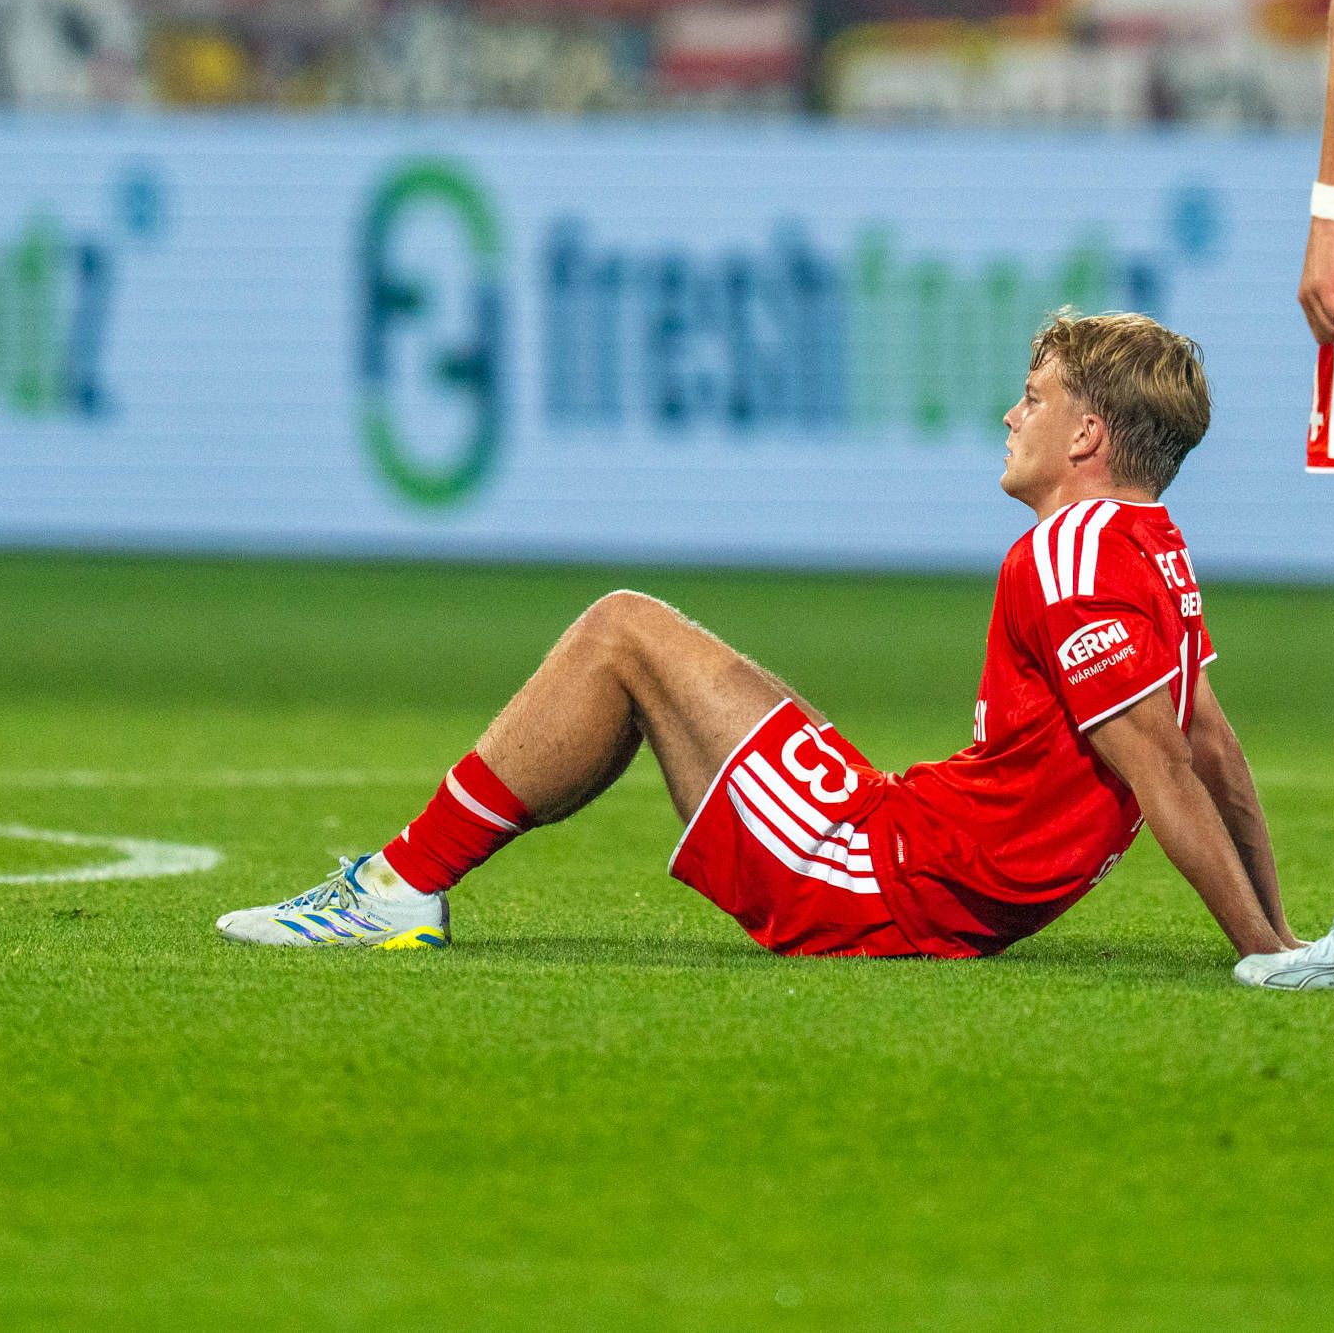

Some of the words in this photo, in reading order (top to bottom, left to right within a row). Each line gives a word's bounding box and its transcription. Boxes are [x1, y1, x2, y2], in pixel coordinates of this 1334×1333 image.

[1155, 551, 1185, 589] FC
[1057, 619, 1129, 671] KERMI
[1068, 644, 1136, 686] WÄRMEPUMPE
